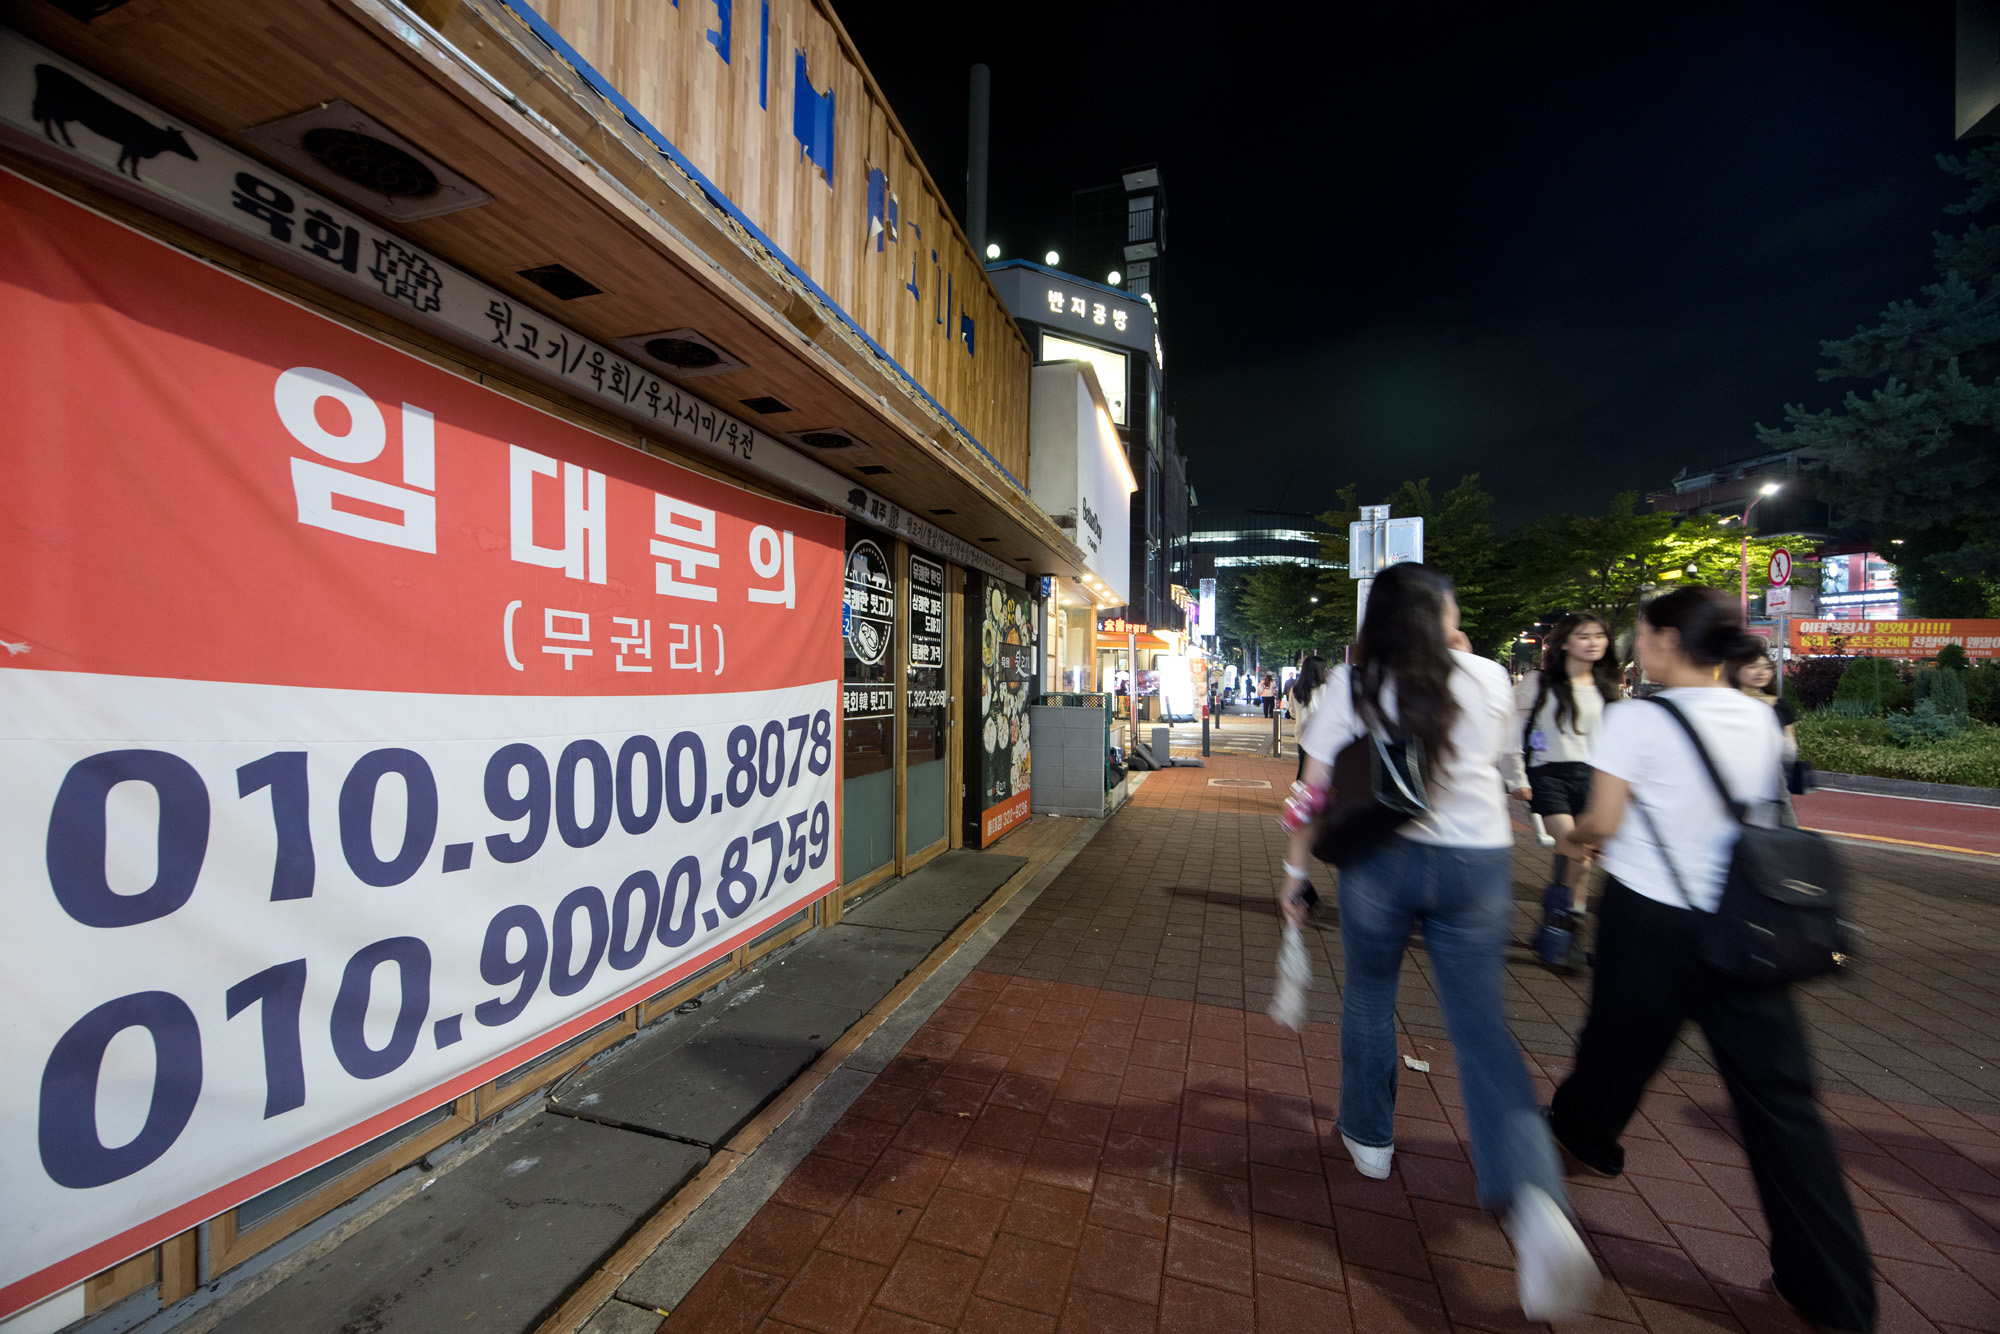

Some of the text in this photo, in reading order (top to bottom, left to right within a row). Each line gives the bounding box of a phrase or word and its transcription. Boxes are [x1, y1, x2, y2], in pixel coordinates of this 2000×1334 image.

[1048, 290, 1128, 331] 반지공방
[931, 569, 942, 588] 한우
[870, 593, 893, 618] 뒷고기
[930, 599, 942, 616] 제주
[503, 600, 725, 676] (무권리)
[1800, 621, 1871, 634] 이태원참사
[930, 645, 941, 662] 가격
[870, 690, 893, 711] 뒷고기
[46, 708, 832, 929] 010.9000.8078
[38, 801, 831, 1190] 010.9000.8759
